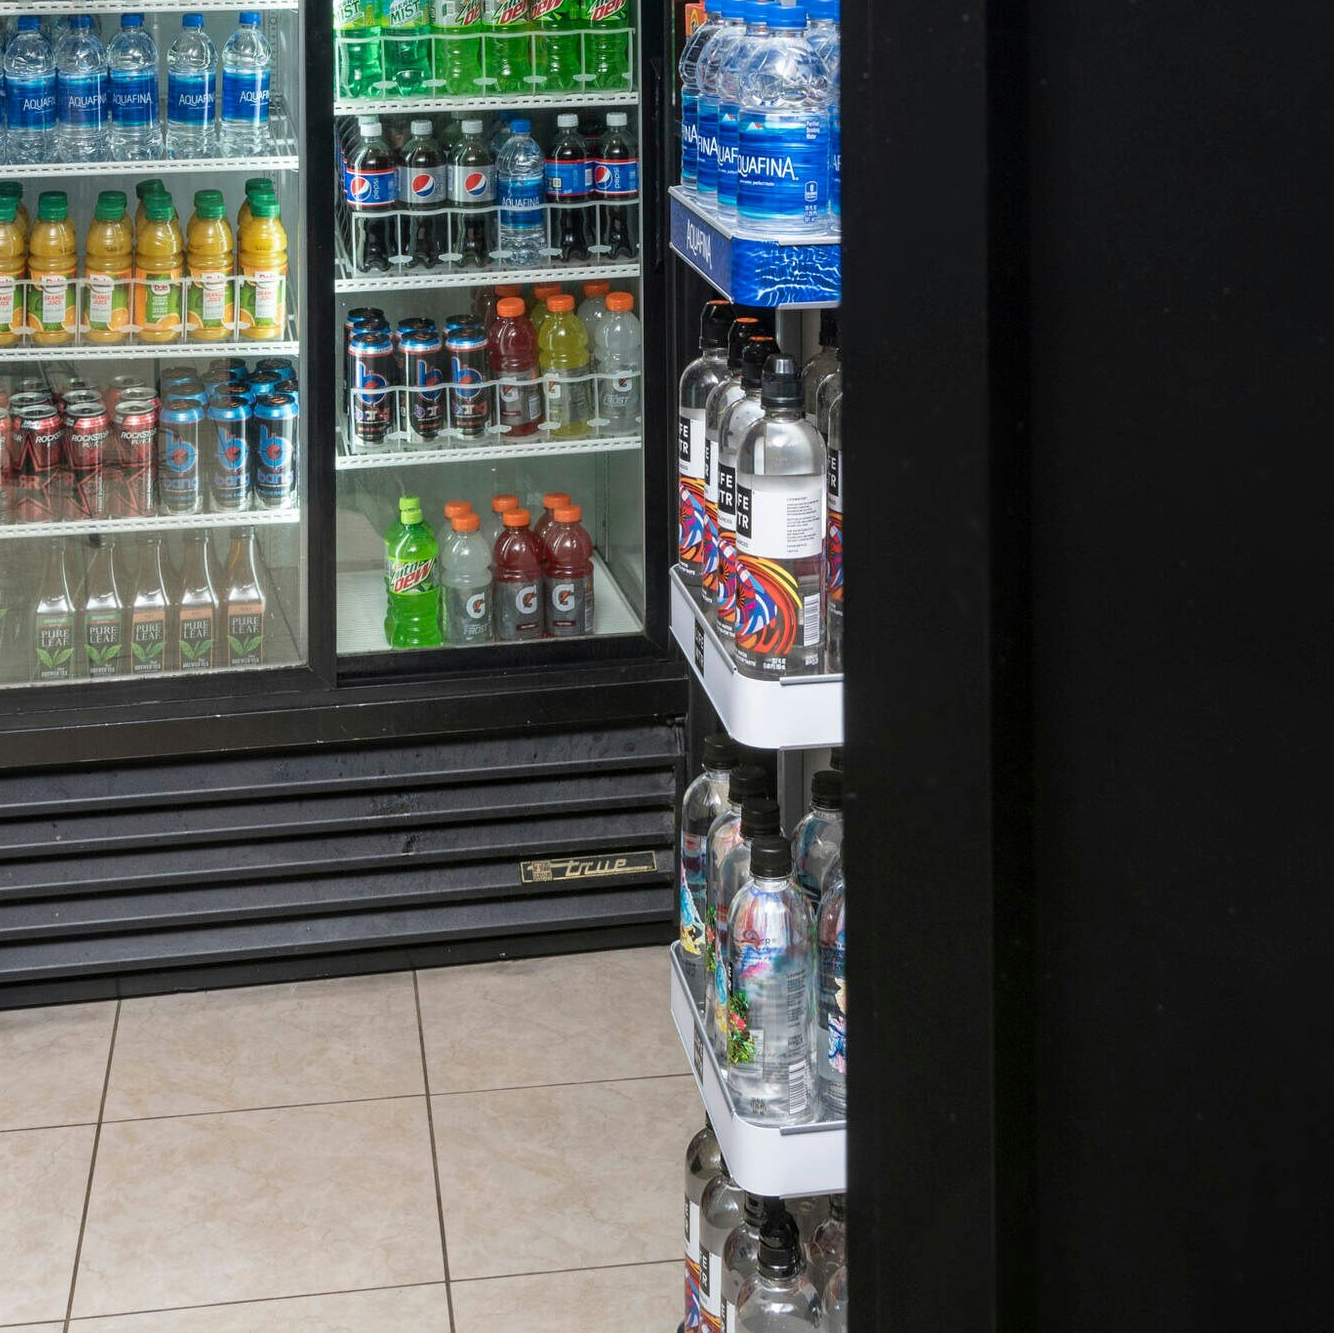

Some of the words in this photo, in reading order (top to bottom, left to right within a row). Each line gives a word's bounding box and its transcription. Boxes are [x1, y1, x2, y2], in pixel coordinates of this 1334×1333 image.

[340, 2, 361, 20] IST
[390, 1, 421, 25] MIST
[68, 93, 107, 108] AQUAFIN
[113, 92, 153, 106] AQUAFINA
[178, 92, 216, 106] AQUAFIN
[240, 89, 270, 104] AQUAFI
[738, 156, 796, 181] QUAFINA
[613, 166, 622, 189] pepsi
[373, 177, 381, 201] pepsi
[686, 218, 713, 270] AQUAFINA
[720, 472, 733, 488] FE
[719, 493, 733, 507] TR
[737, 494, 749, 510] FE
[737, 513, 749, 529] TR
[232, 616, 260, 626] PURE
[41, 629, 70, 639] PURE
[89, 626, 119, 635] PURE
[232, 625, 260, 635] LEAF
[41, 638, 69, 647] LEAF
[89, 634, 117, 644] LEAF
